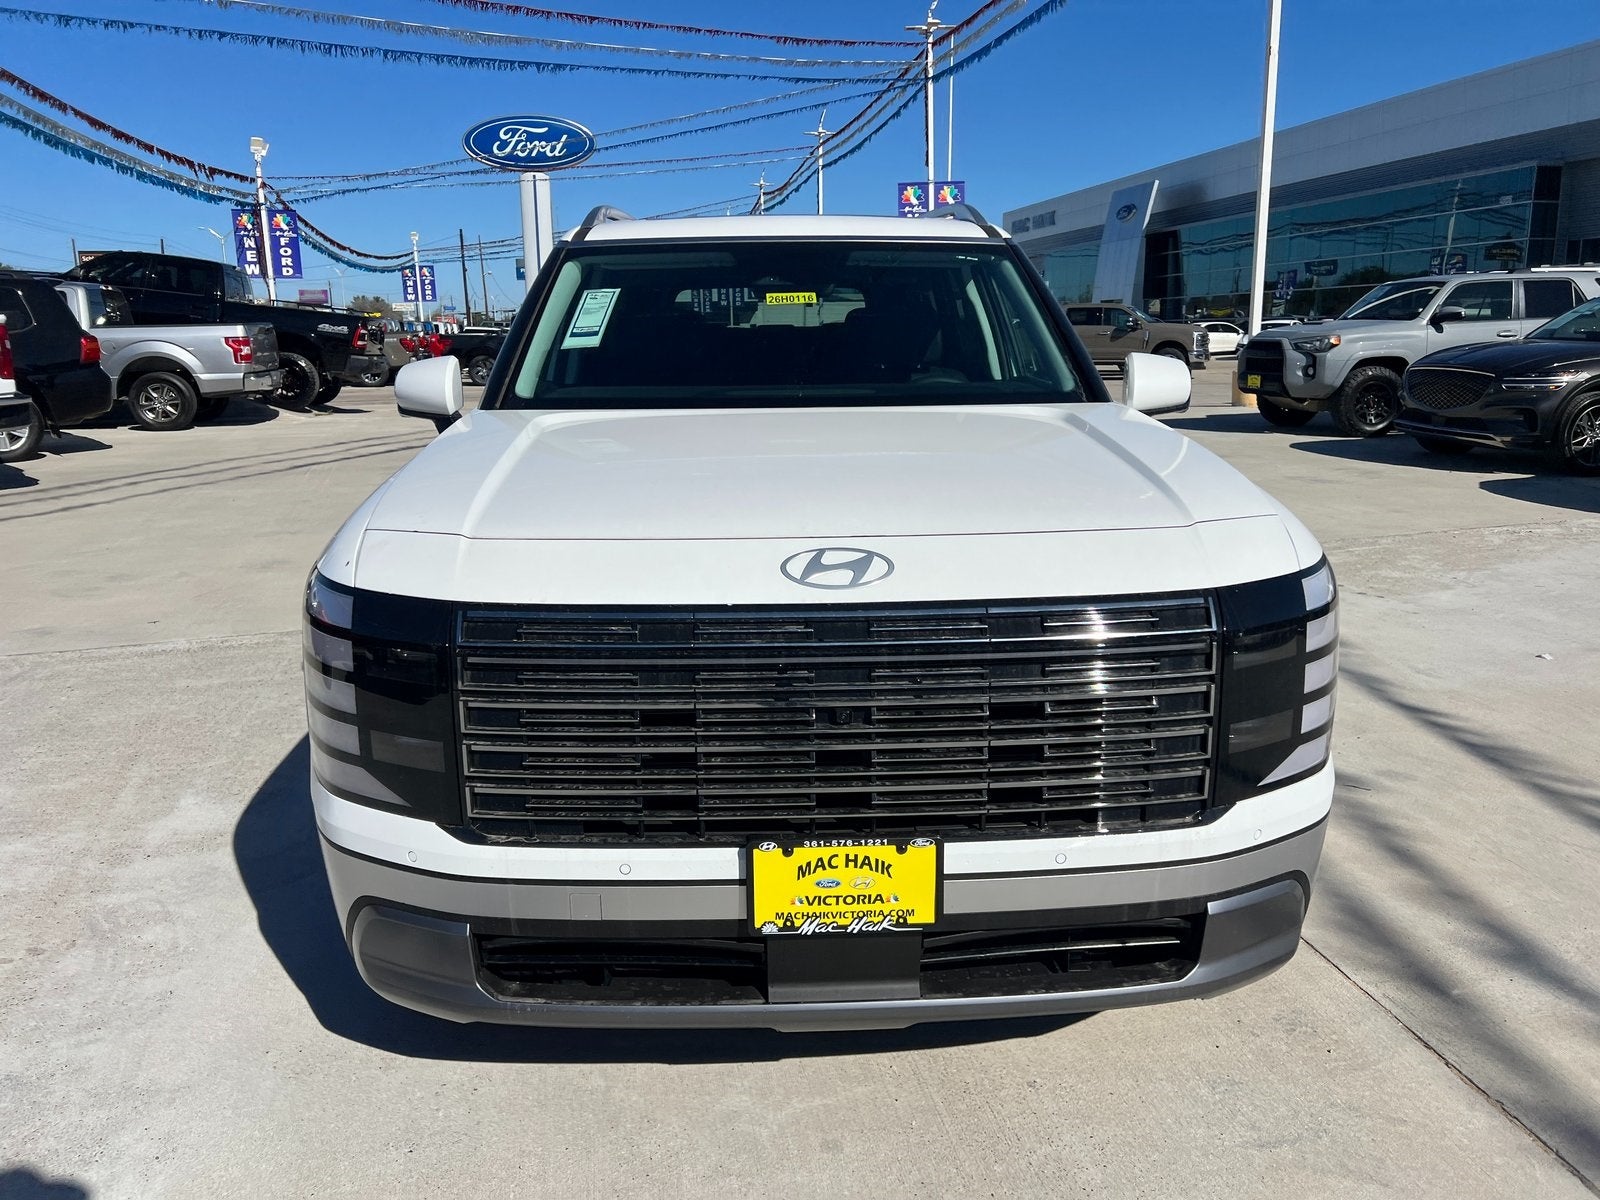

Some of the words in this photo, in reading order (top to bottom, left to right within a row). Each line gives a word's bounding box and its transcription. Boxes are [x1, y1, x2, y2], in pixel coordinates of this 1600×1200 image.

[492, 125, 568, 157] Ford
[243, 236, 260, 276] NEW
[279, 237, 294, 276] FORD
[768, 294, 814, 304] 26H0116
[803, 839, 888, 848] 361-576-1221
[797, 853, 839, 881] MAC
[844, 853, 893, 879] HAIK
[804, 893, 885, 907] VICTORIA
[775, 909, 915, 920] MACHAIKVICTORIACOM
[798, 916, 839, 936] Mac
[846, 915, 894, 934] Haik
